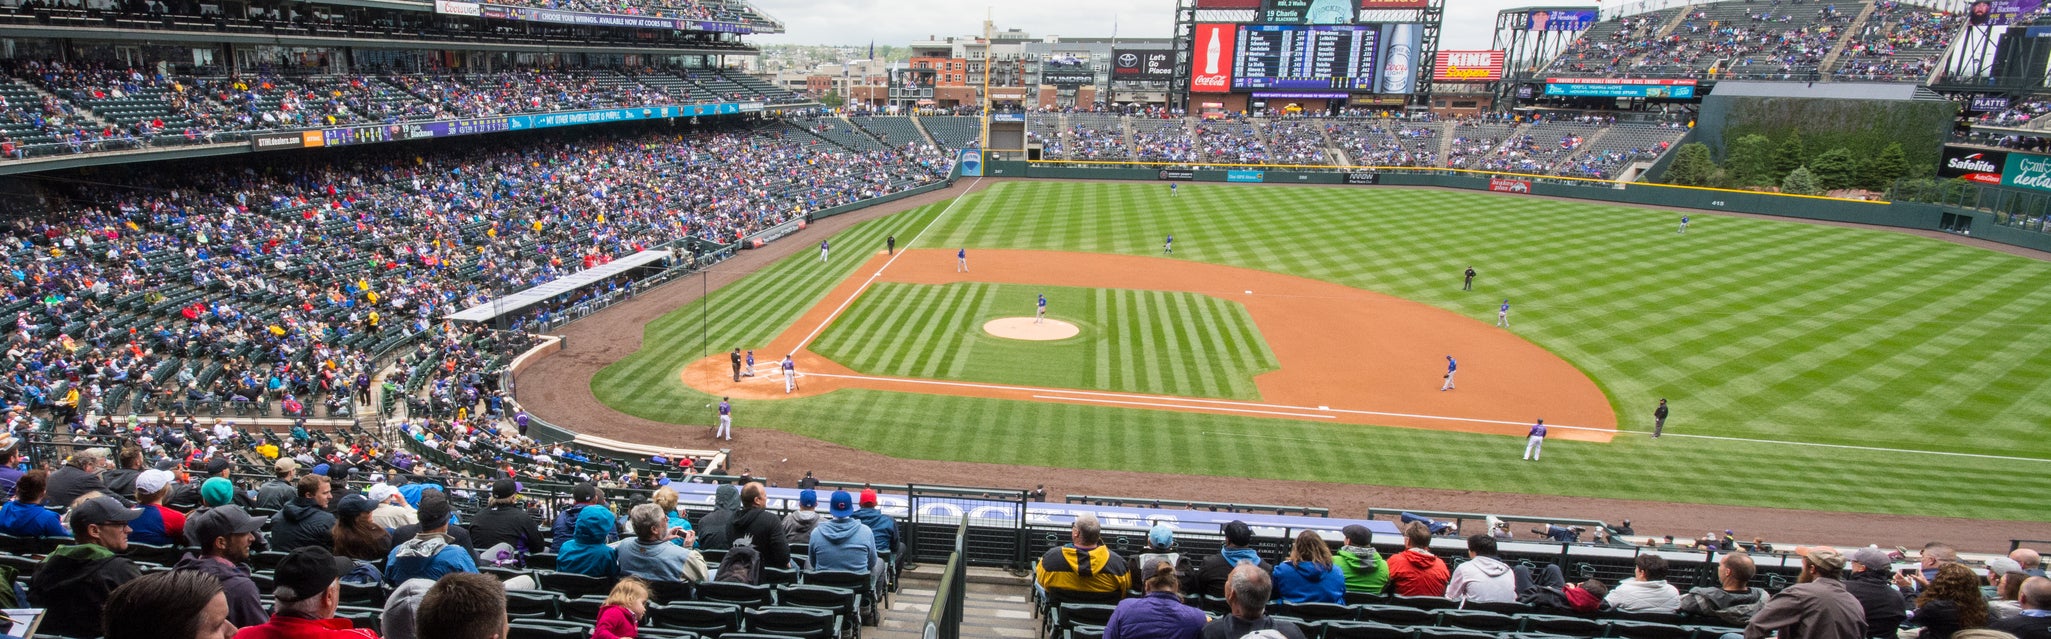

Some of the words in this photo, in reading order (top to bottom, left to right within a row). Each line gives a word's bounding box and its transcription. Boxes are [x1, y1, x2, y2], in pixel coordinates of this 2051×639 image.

[463, 6, 479, 14] LIGHT
[541, 13, 561, 21] CHOOSE
[599, 17, 625, 25] AVAILABLE
[1149, 53, 1166, 61] Let's
[1447, 52, 1491, 66] KING
[1445, 65, 1490, 80] Soopers
[1195, 75, 1227, 86] Coca-Cola
[1974, 99, 2006, 107] PLATTE
[546, 115, 554, 124] MY
[555, 115, 569, 124] OTHER
[569, 113, 588, 122] FAVORITE
[588, 112, 600, 121] COLOR
[601, 112, 605, 120] IS
[402, 124, 409, 133] 19
[410, 129, 434, 138] Blackmon
[258, 137, 300, 147] STIHLdealers.com
[1948, 158, 1996, 173] Safelite
[1973, 173, 2001, 183] AutoGlass
